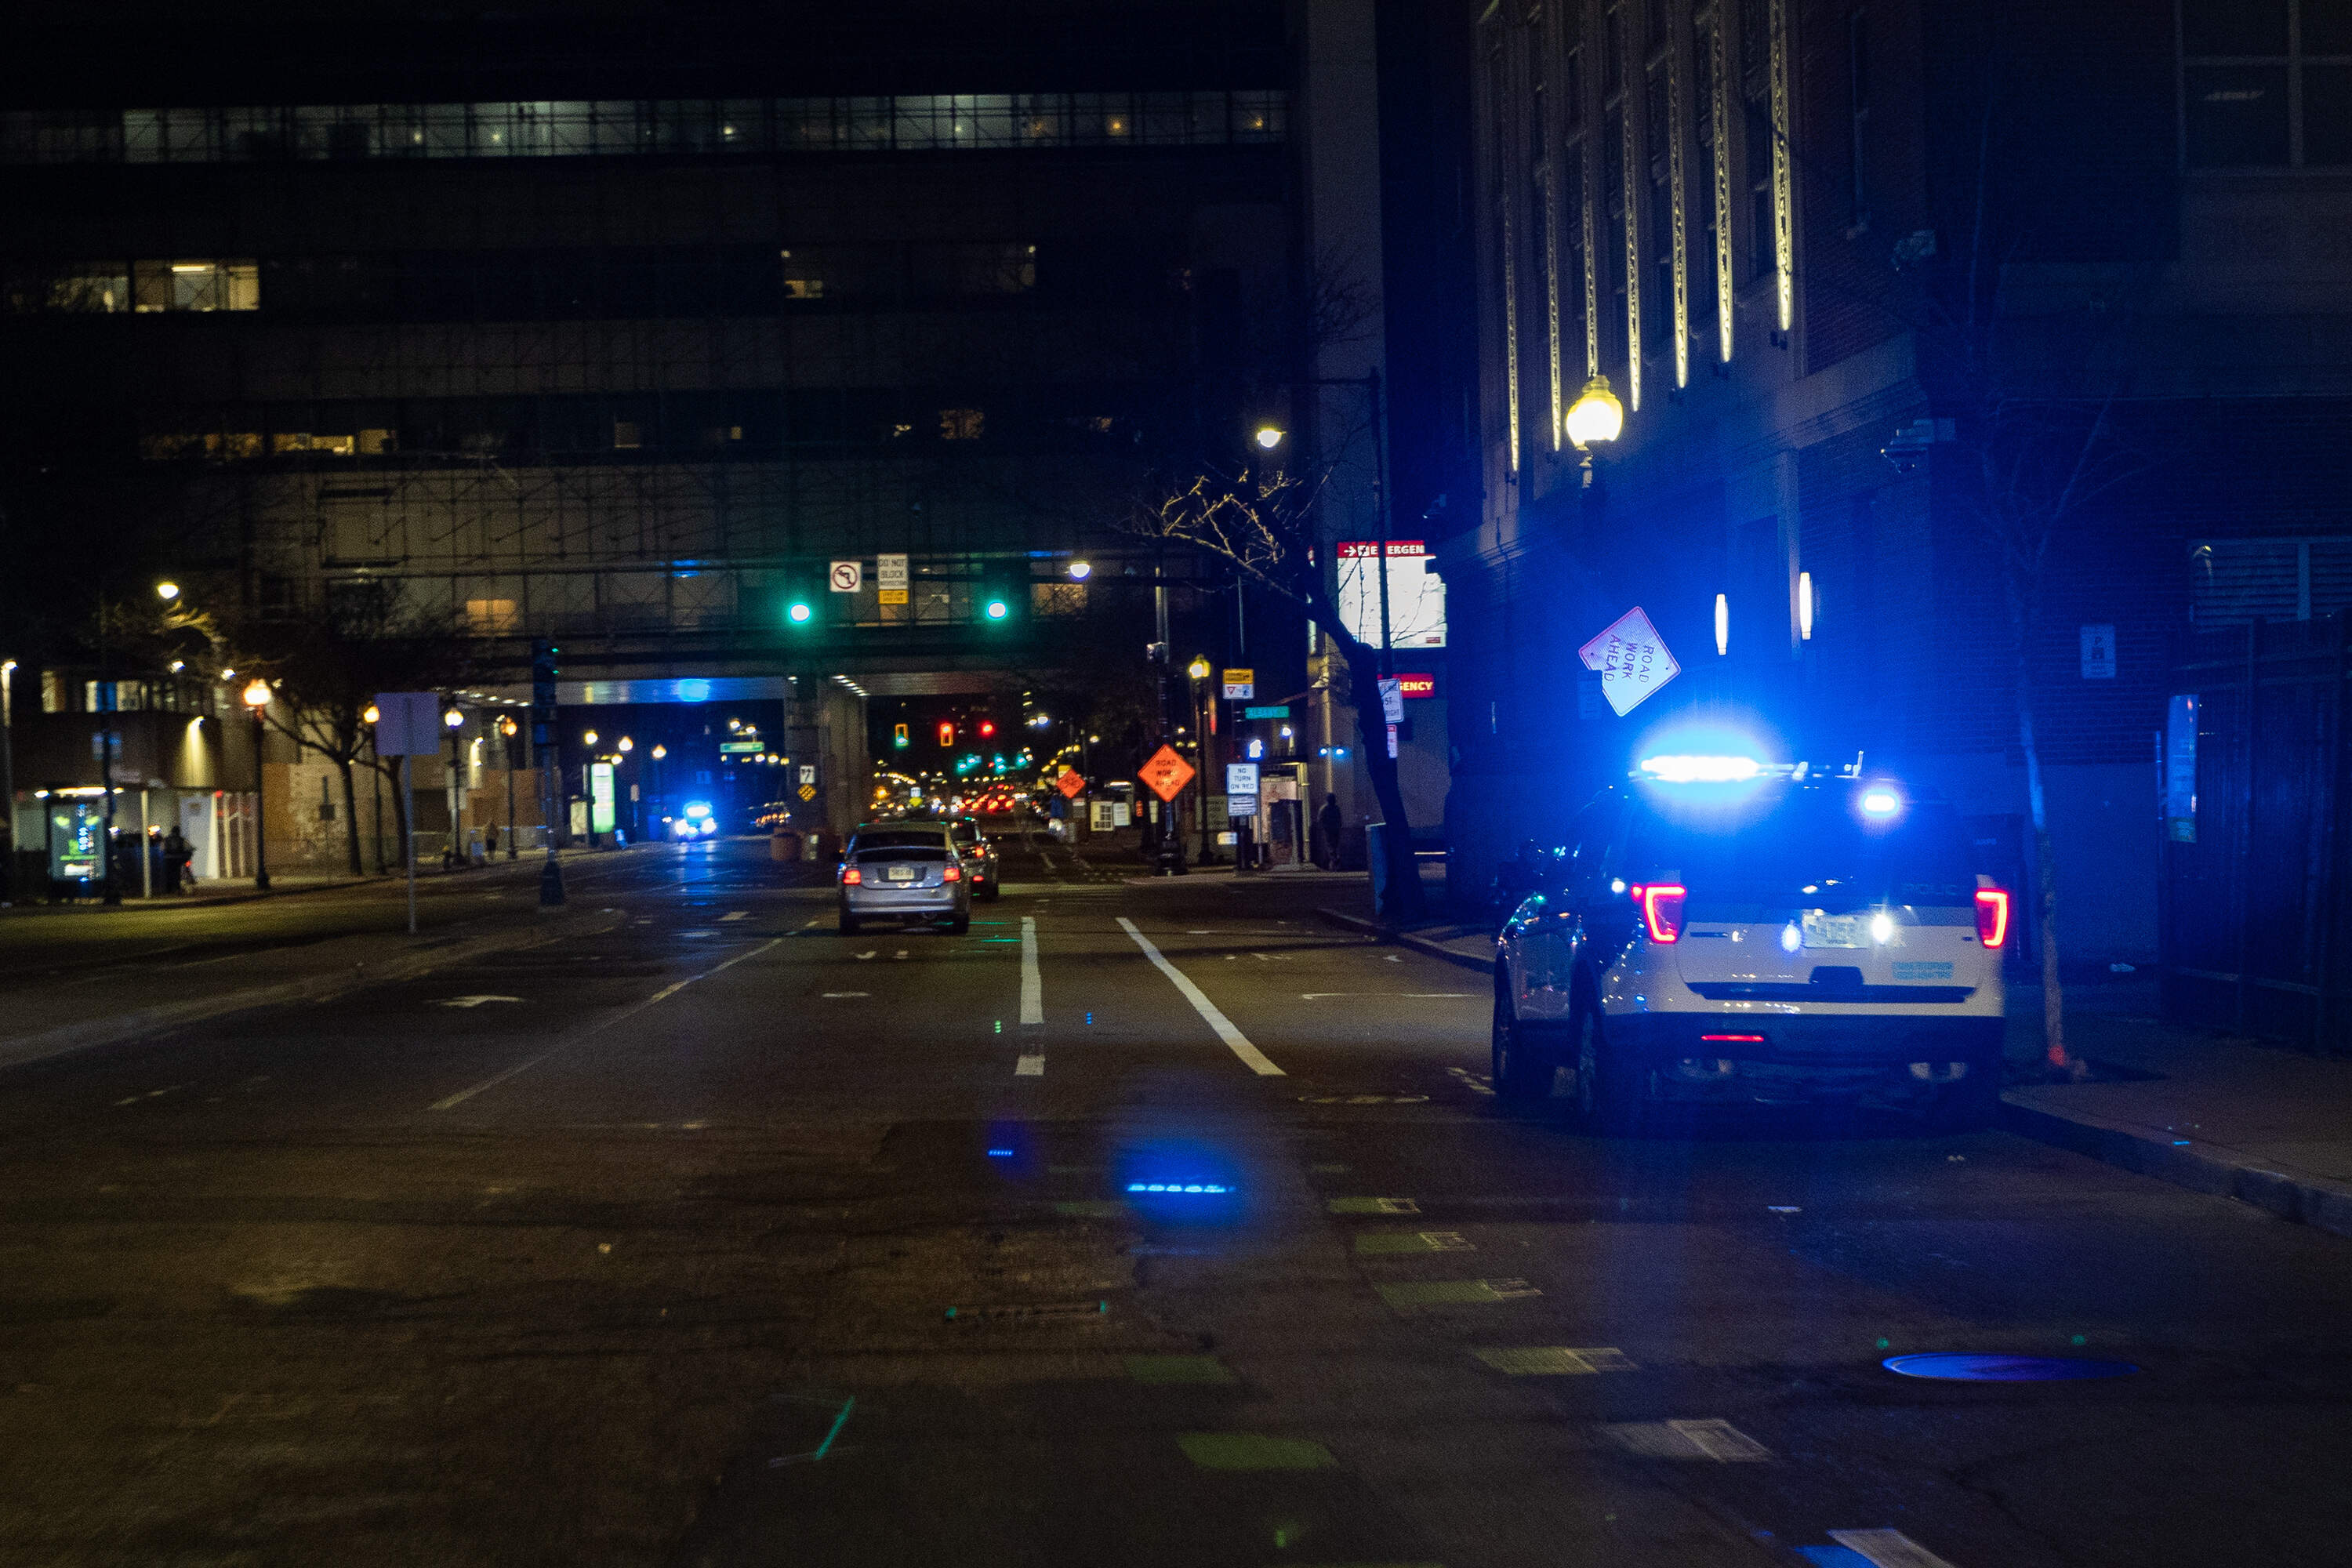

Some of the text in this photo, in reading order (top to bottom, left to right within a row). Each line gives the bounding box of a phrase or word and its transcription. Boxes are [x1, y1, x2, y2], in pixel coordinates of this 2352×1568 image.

[1370, 544, 1425, 555] EERGEN
[878, 558, 905, 567] DO NOT
[1604, 633, 1621, 681] AHEAD
[1621, 643, 1639, 680] WORK
[1639, 645, 1654, 683] ROAD
[1902, 883, 1969, 896] POLIC
